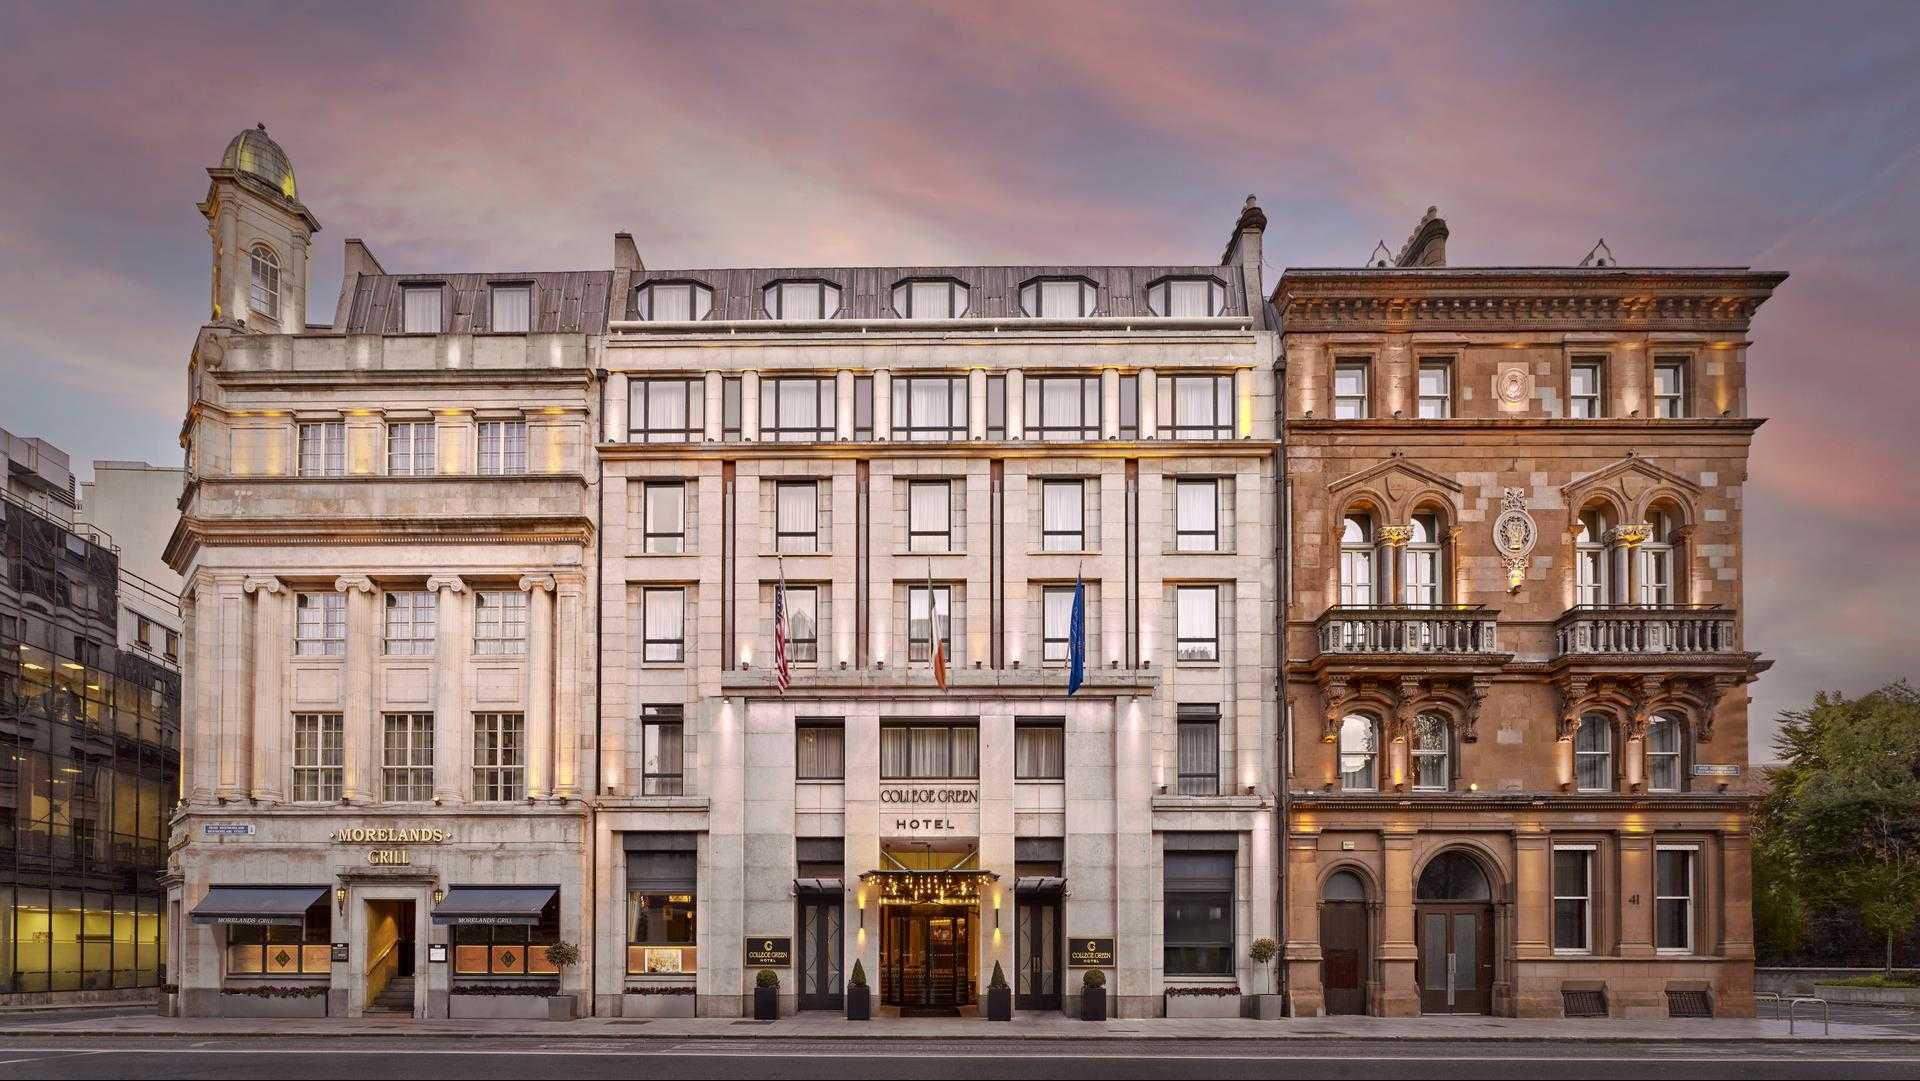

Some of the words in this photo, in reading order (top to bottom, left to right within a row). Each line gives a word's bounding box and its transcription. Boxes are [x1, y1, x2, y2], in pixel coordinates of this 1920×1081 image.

[881, 789, 936, 803] COLLEGE
[938, 789, 978, 803] GREEN
[896, 819, 955, 830] HOTEL
[338, 827, 443, 842] MORELANDS
[368, 850, 410, 864] GRILL
[1628, 894, 1640, 906] 41
